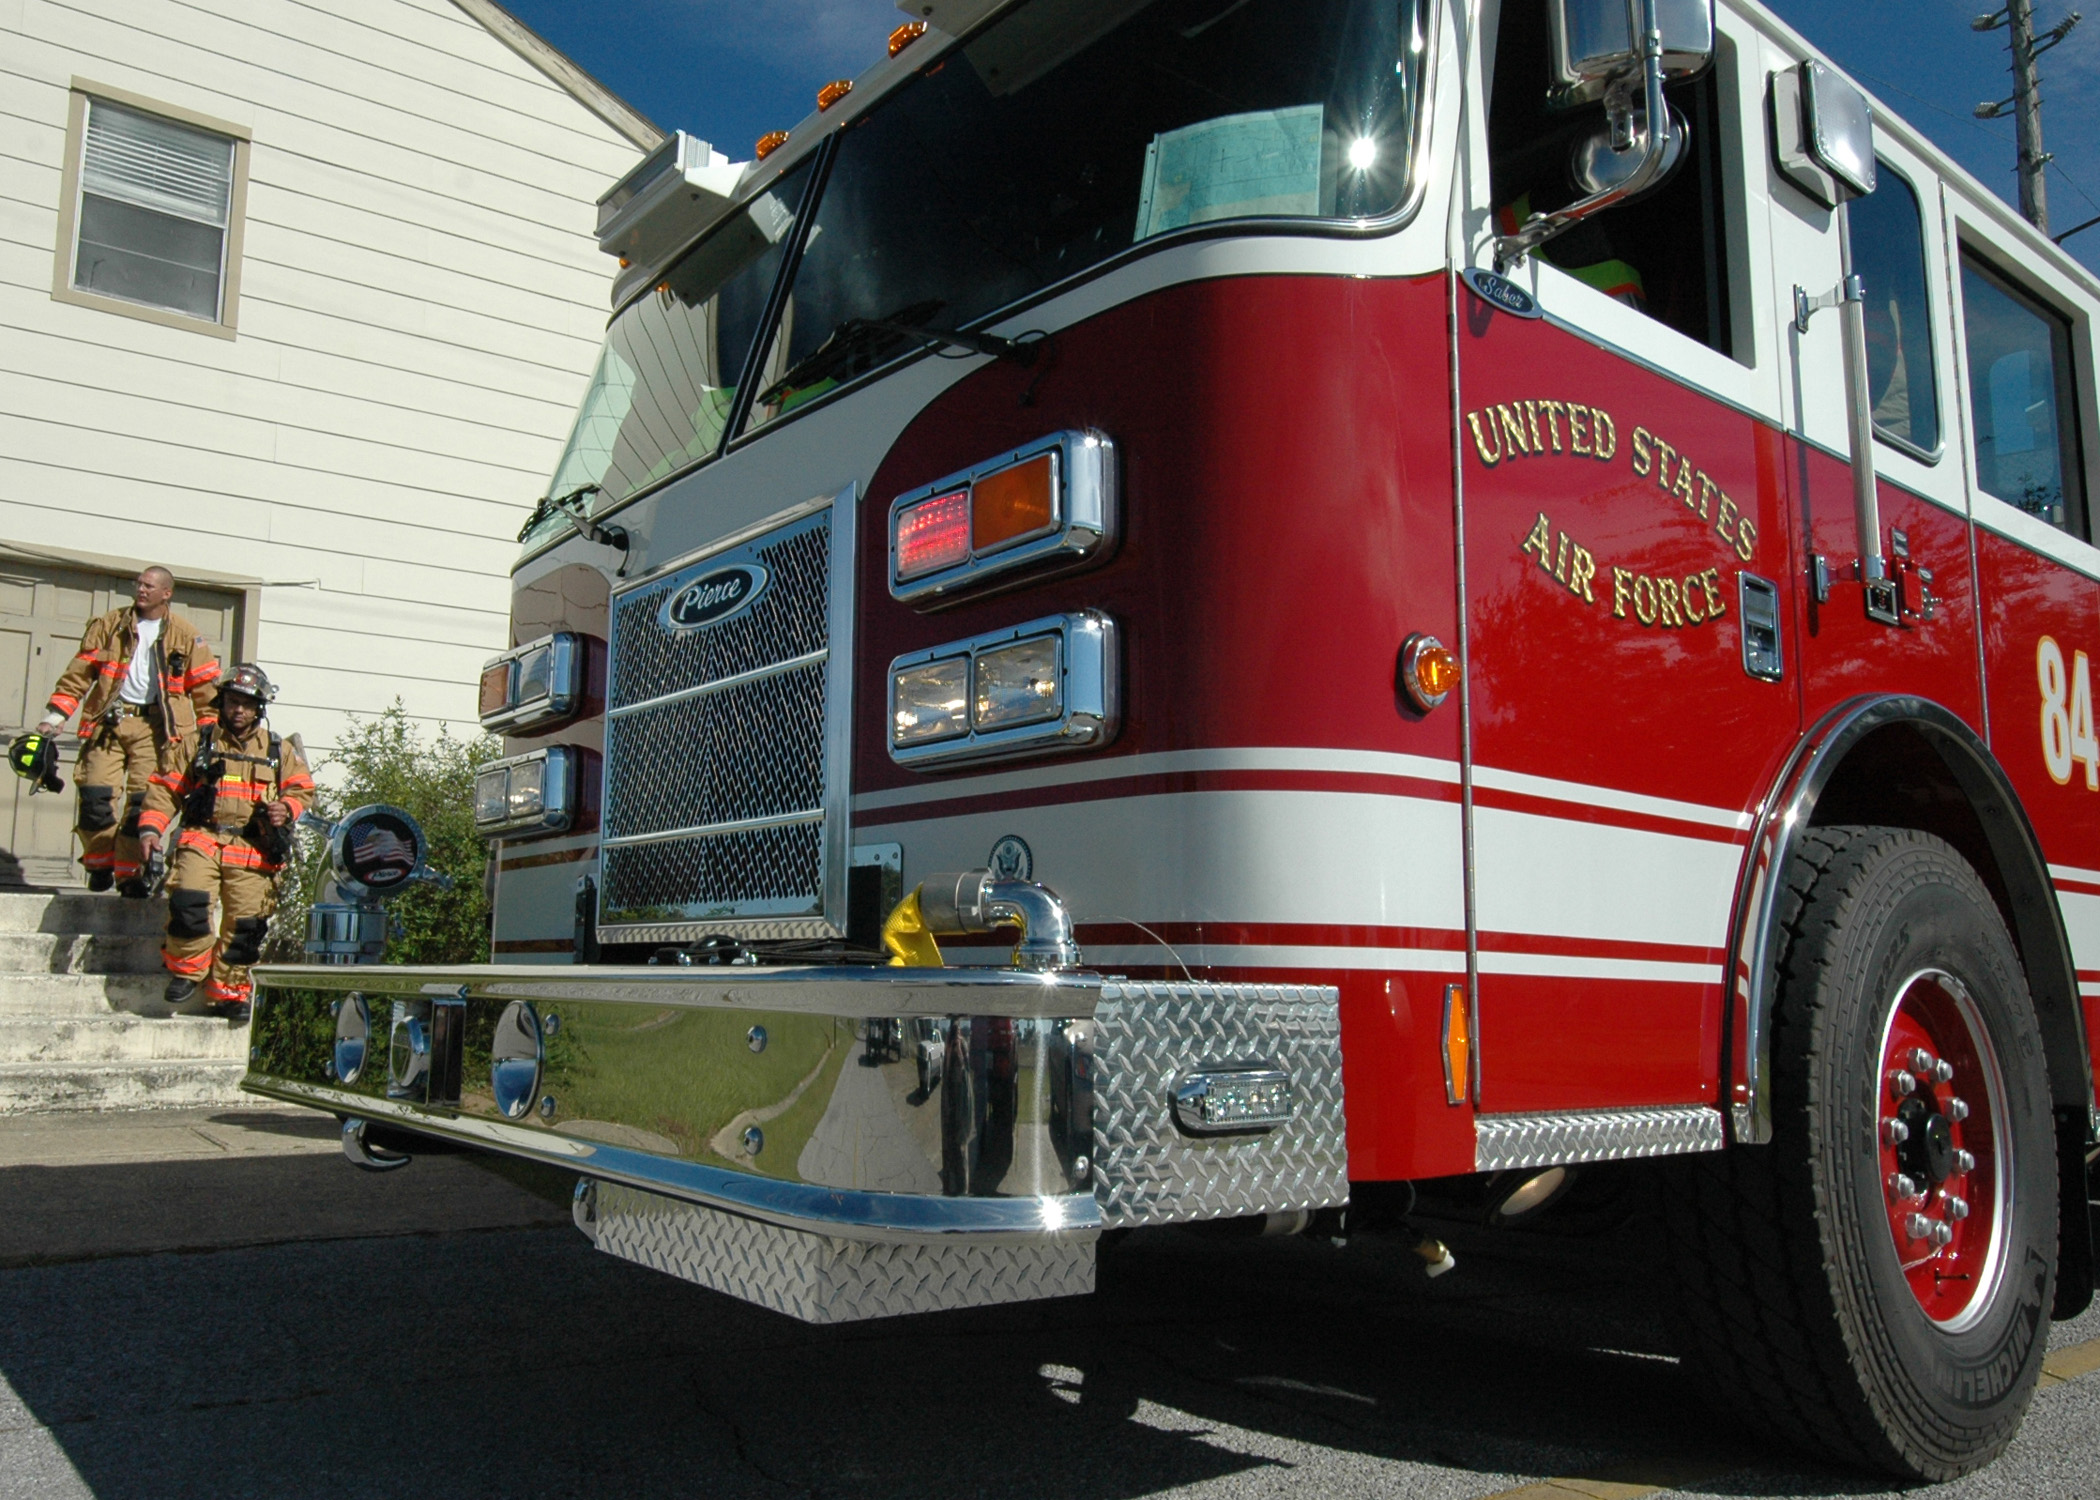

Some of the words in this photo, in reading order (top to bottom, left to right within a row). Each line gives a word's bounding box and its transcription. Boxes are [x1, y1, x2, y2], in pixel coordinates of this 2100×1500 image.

[1467, 399, 1617, 464] UNITED
[1632, 426, 1757, 562] STATES
[679, 578, 742, 621] Pierce
[1520, 512, 1596, 604] AIR
[1612, 567, 1726, 627] FORCE
[2036, 635, 2100, 792] 84
[1935, 1306, 2033, 1402] MICHELIN
